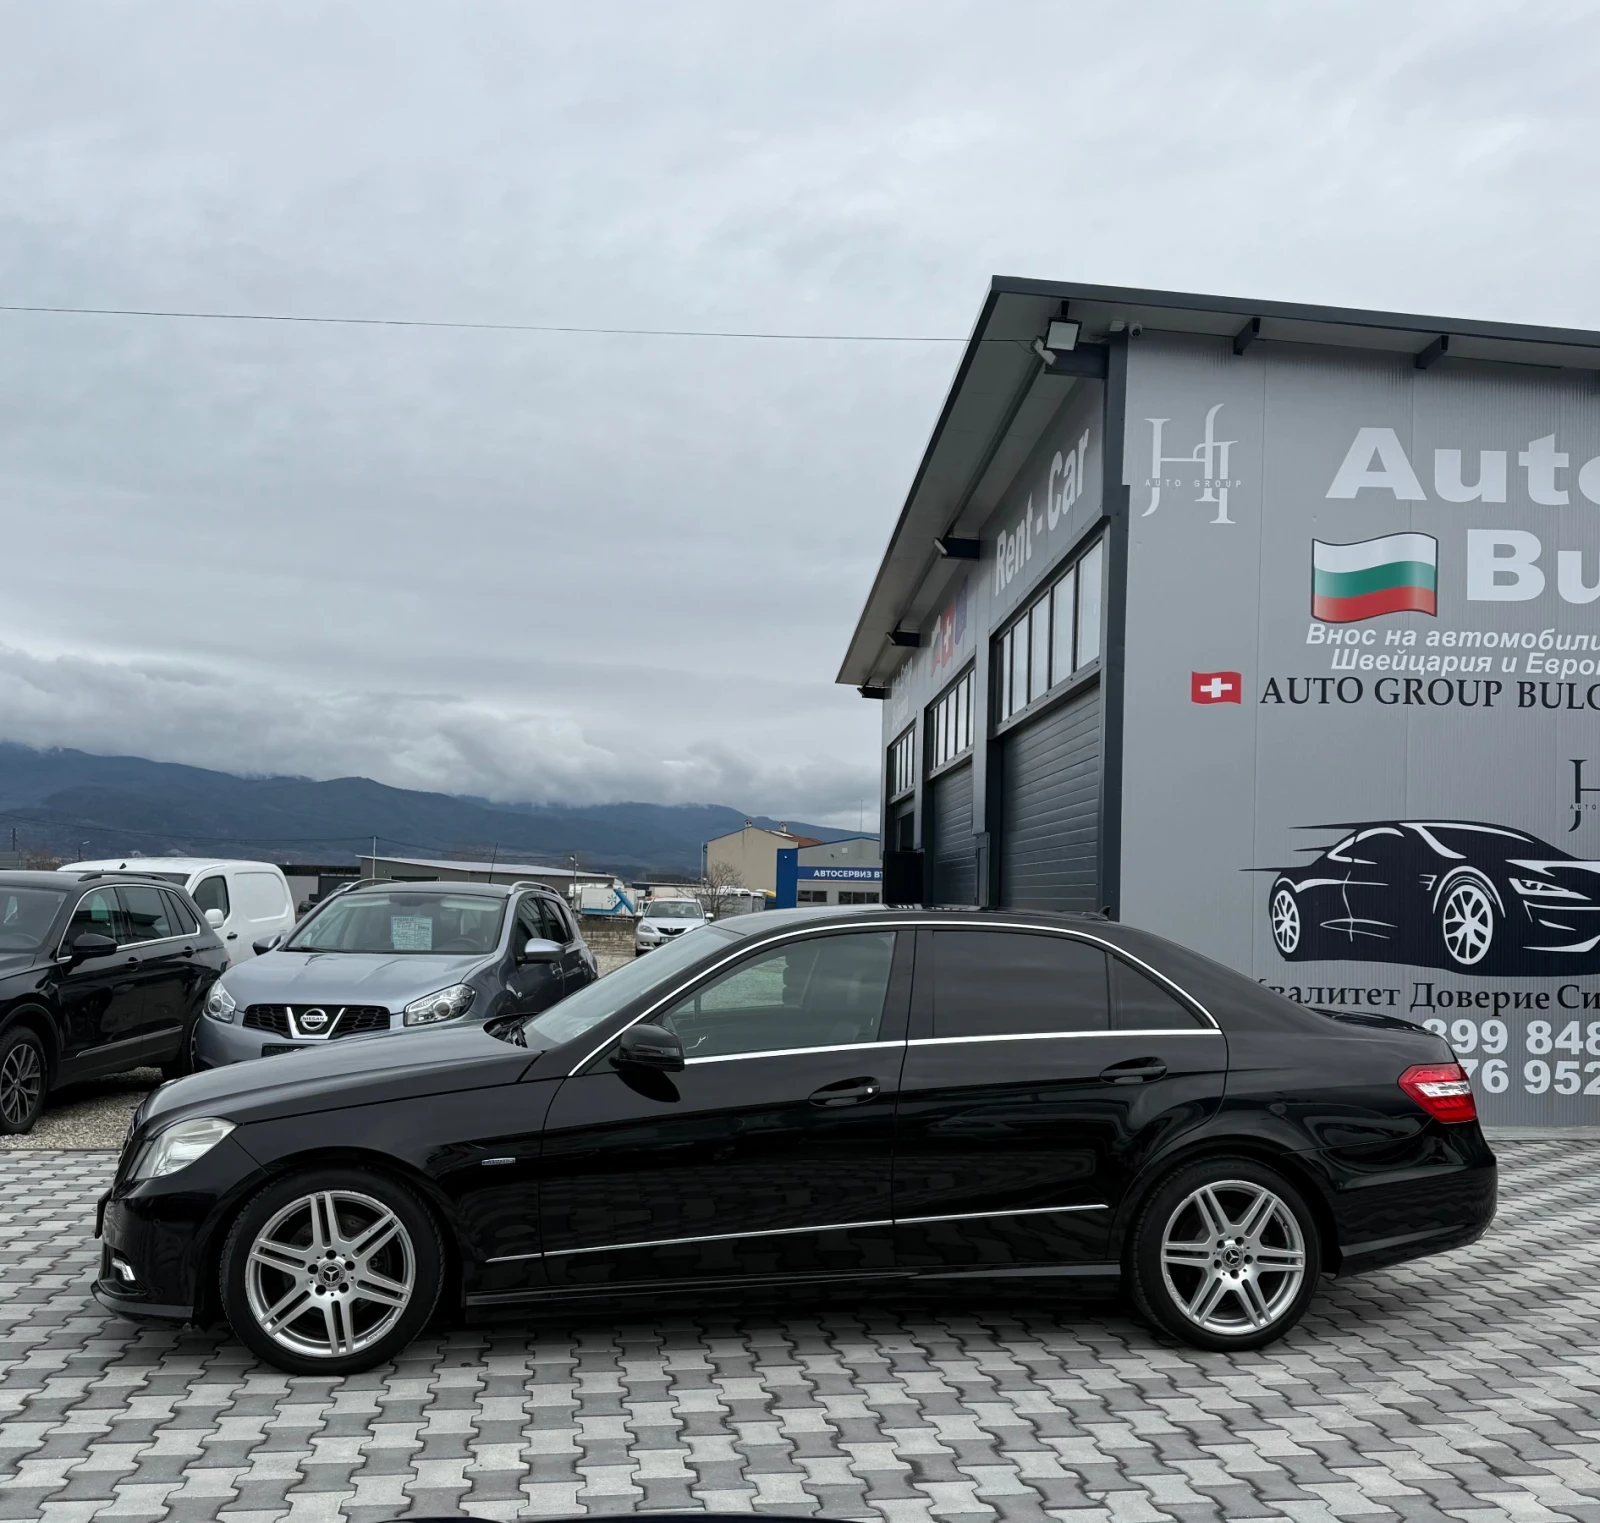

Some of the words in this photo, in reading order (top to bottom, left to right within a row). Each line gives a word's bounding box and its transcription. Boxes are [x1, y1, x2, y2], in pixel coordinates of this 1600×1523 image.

[1145, 479, 1181, 487] AUTO
[1194, 479, 1242, 488] GROUP
[995, 491, 1033, 597] Rent
[1047, 428, 1090, 532] Car
[1306, 623, 1377, 645] Внос
[1385, 630, 1417, 647] на
[1331, 648, 1493, 677] Швейцария
[1501, 656, 1518, 673] и
[1525, 652, 1600, 680] Евро
[1259, 676, 1364, 704] AUTO
[1374, 677, 1503, 707] GROUP
[813, 870, 872, 878] АВТОСЕРВИЗ
[1409, 982, 1551, 1017] Доверие
[1525, 1020, 1600, 1056] 848
[1523, 1059, 1600, 1096] 952
